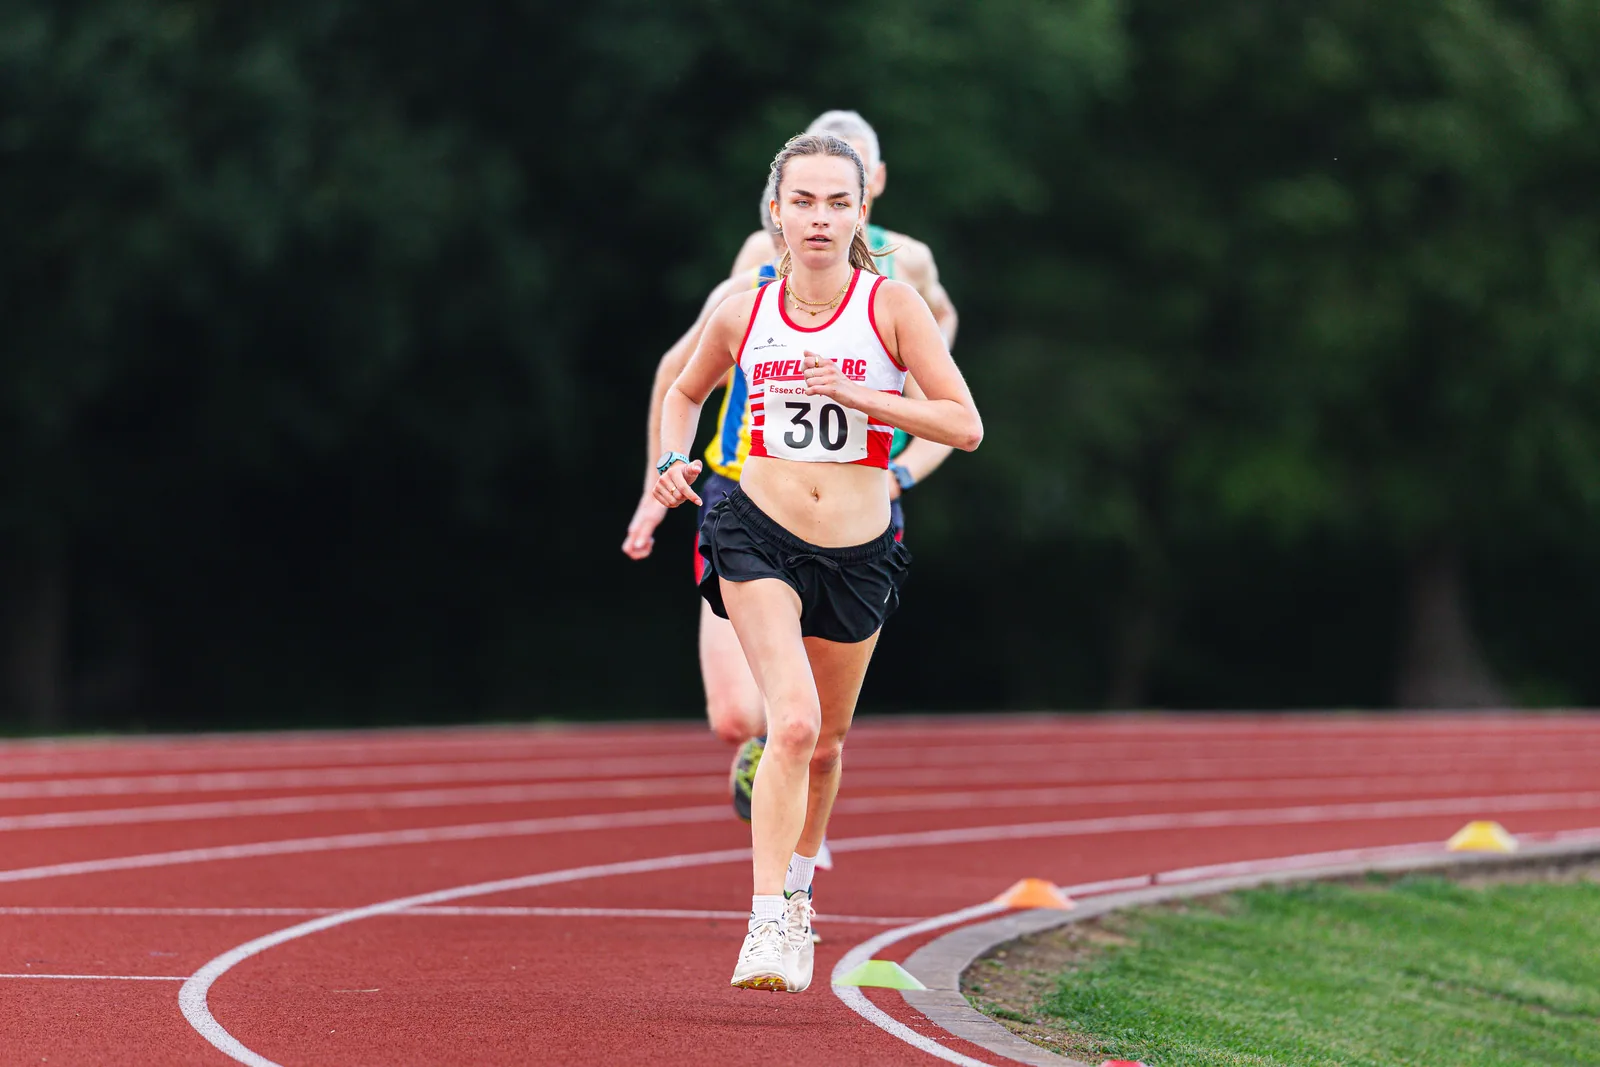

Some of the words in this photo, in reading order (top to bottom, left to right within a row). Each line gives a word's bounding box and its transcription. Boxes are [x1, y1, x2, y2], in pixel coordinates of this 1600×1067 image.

[753, 358, 838, 380] BENFL
[842, 358, 867, 376] RC
[769, 385, 794, 394] Essex
[784, 402, 848, 451] 30
